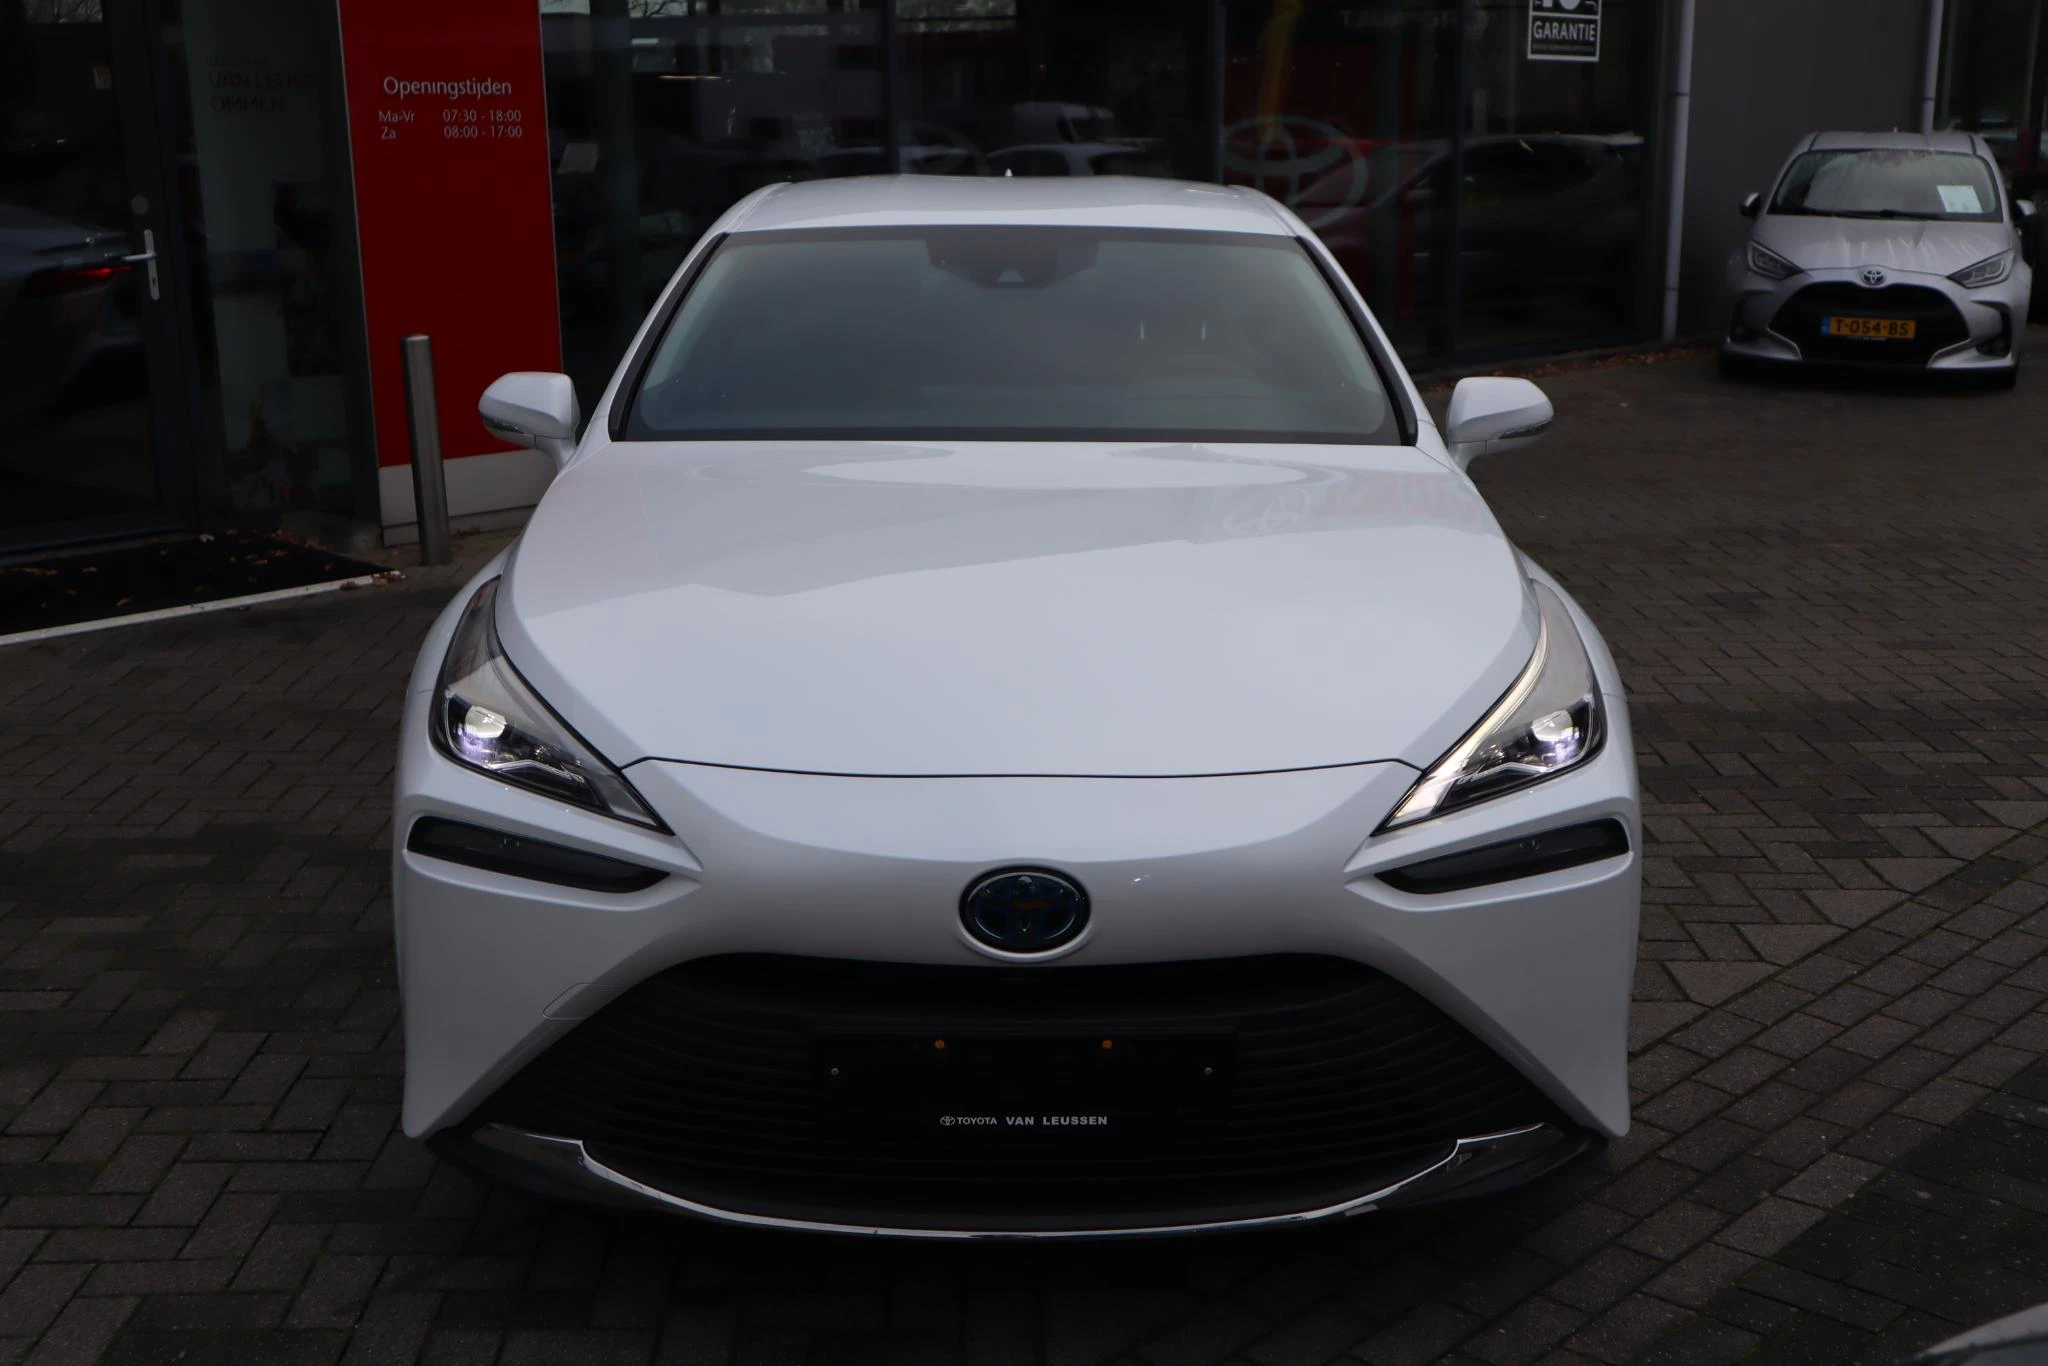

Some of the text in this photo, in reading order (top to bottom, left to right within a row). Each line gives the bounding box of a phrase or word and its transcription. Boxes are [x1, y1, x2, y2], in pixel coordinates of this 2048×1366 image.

[1533, 20, 1596, 41] GARANTIE
[383, 75, 512, 100] Openingstijden
[442, 108, 477, 122] 07:30
[490, 108, 521, 122] 18:00
[380, 126, 397, 140] Za
[443, 125, 478, 139] 08:00
[491, 125, 523, 138] 17:00
[1835, 318, 1909, 337] T-054-BS
[957, 1115, 1108, 1126] TOYOTA VAN LEUSSEN
